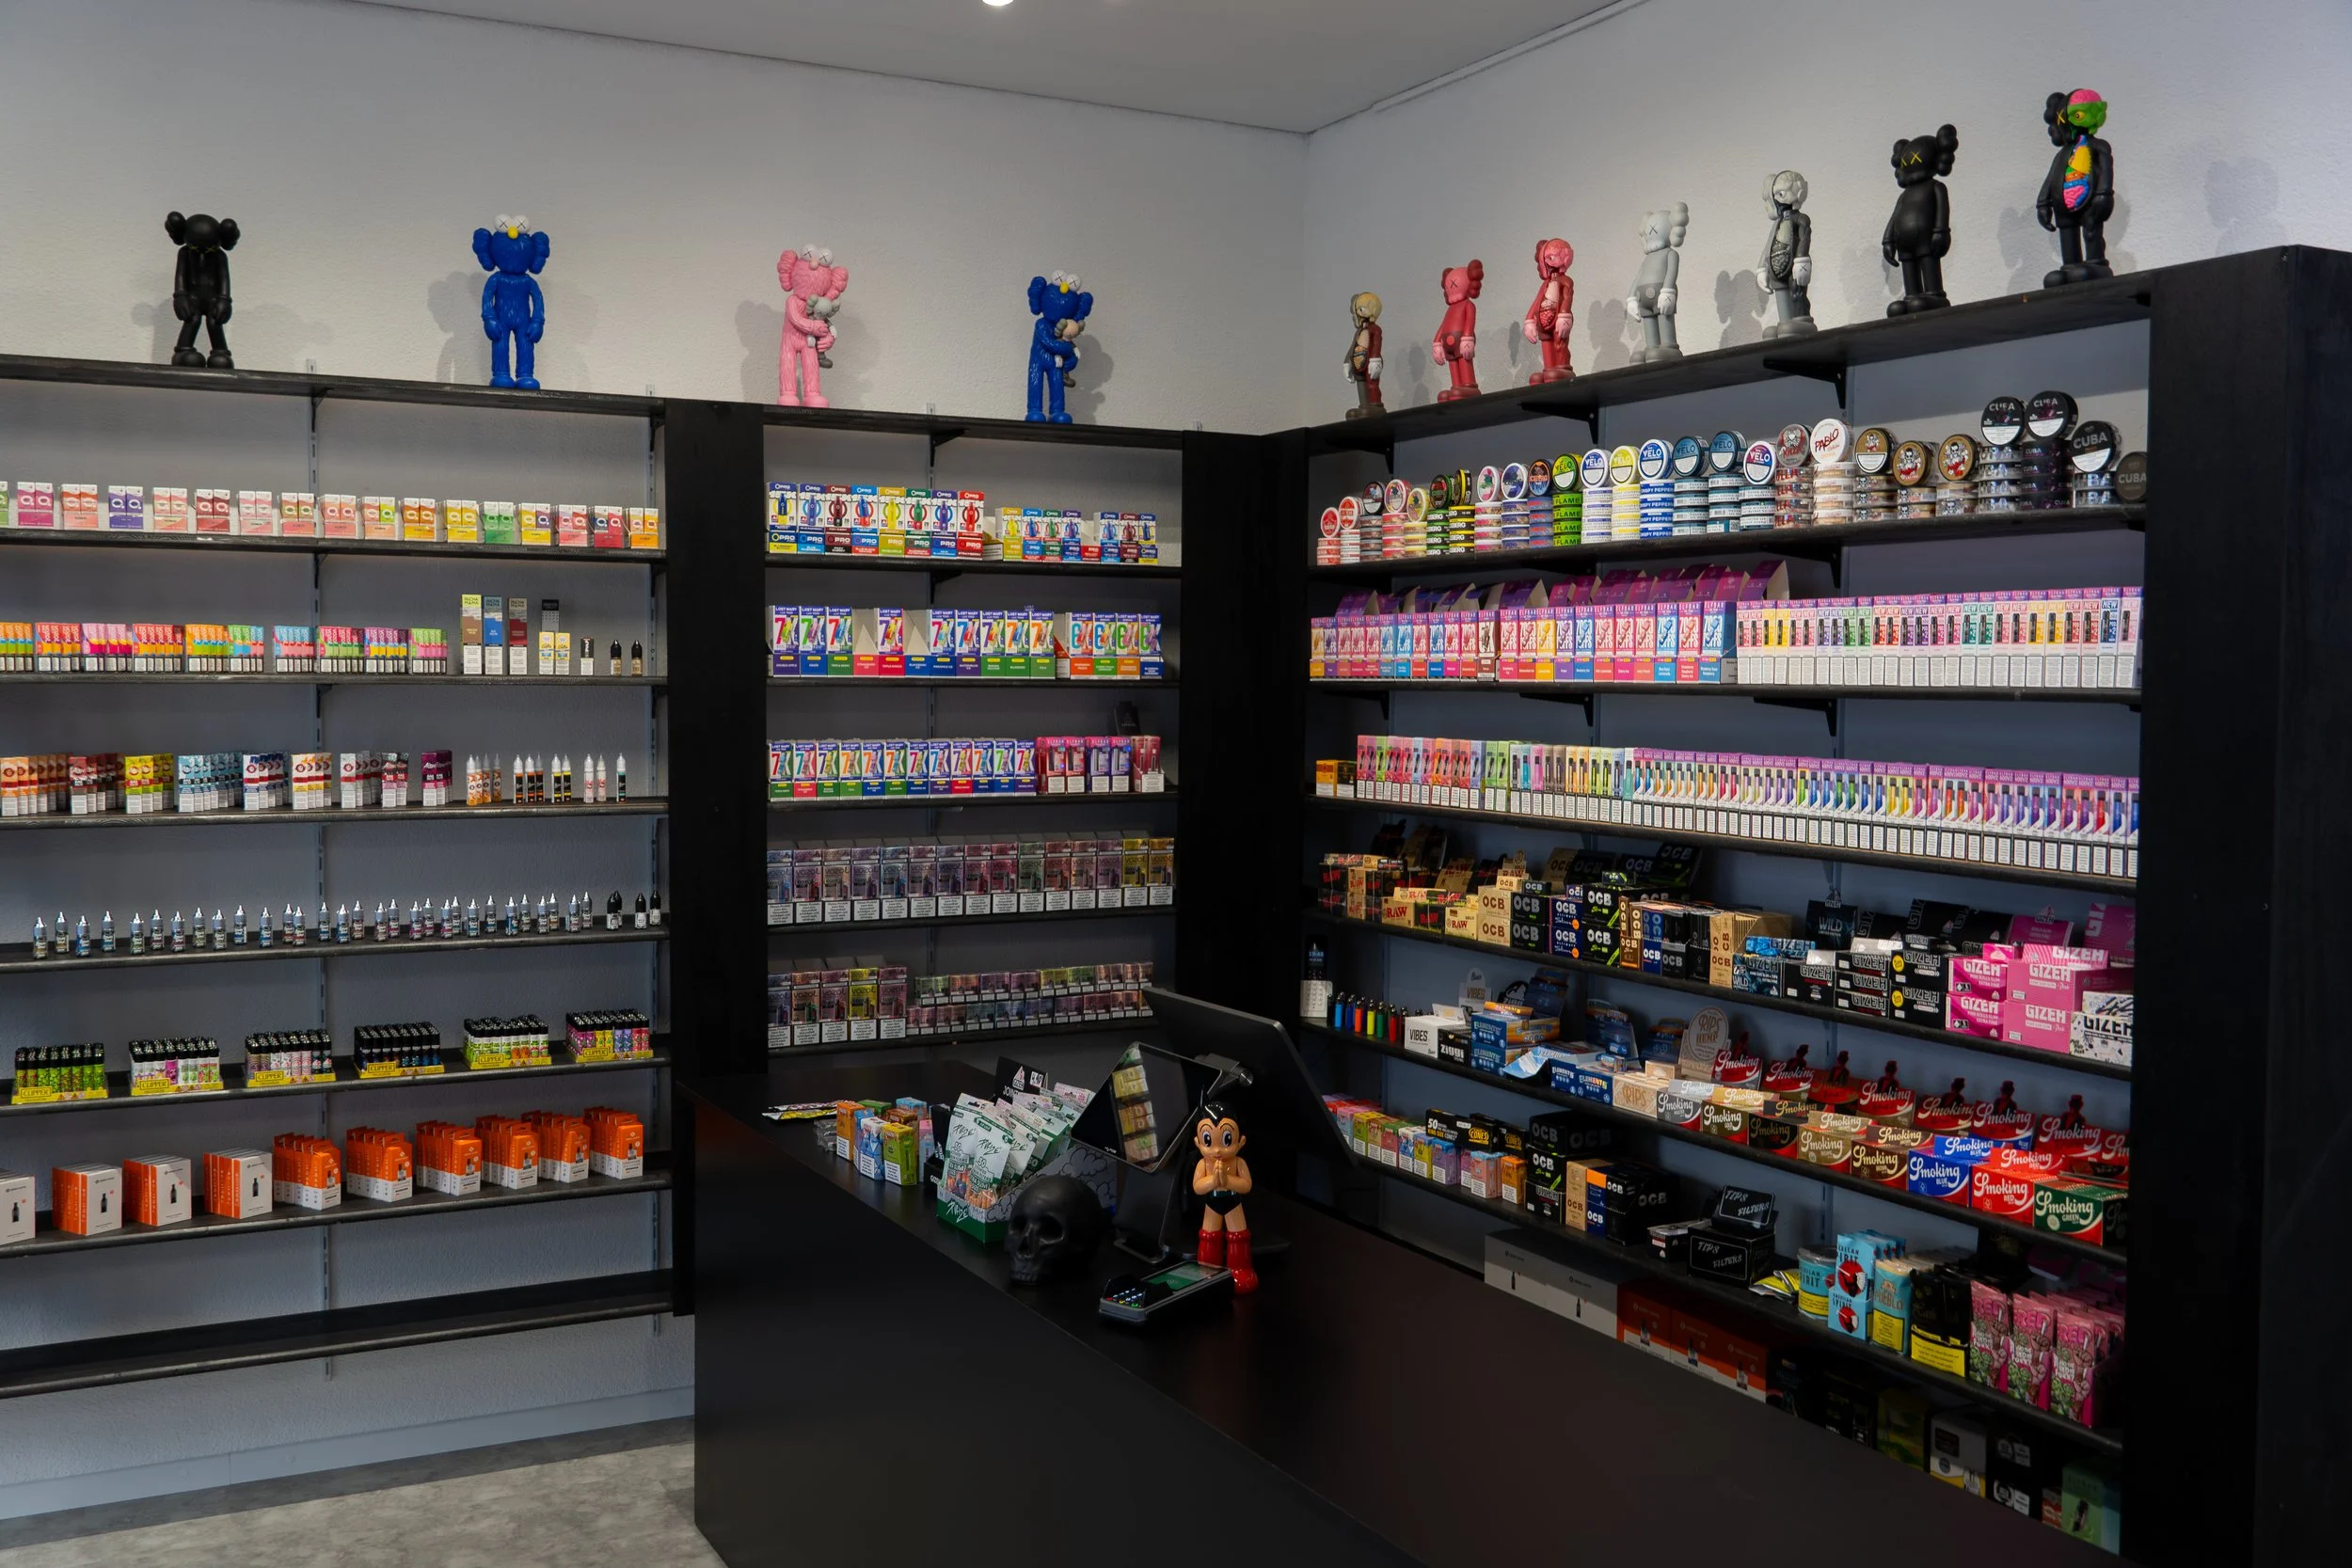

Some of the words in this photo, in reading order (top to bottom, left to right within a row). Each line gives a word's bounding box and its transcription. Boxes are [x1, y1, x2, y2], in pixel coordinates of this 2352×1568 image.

[1713, 440, 1733, 450] VELO
[2073, 432, 2108, 449] CUBA
[1643, 448, 1662, 458] VELO
[1676, 444, 1695, 455] VELO
[1750, 451, 1771, 464] VELO
[1555, 461, 1573, 471] VELO
[2119, 472, 2147, 483] CUBA
[1661, 846, 1693, 860] OCB
[1626, 858, 1654, 872] OCB
[1525, 882, 1543, 891] OCB
[1483, 895, 1505, 910] OCB
[1514, 895, 1540, 912] OCB
[1587, 891, 1612, 906] OCB
[1824, 900, 1841, 909] GIZEH
[1387, 907, 1407, 918] RAW
[1556, 901, 1577, 915] OCB
[1421, 912, 1438, 923] RAW
[1452, 920, 1468, 928] RAW
[1819, 917, 1843, 931] WILD
[1483, 923, 1505, 937] OCB
[1513, 923, 1539, 941] OCB
[1555, 929, 1577, 943] OCB
[1587, 928, 1612, 945] OCB
[1621, 938, 1638, 948] OCB
[1644, 949, 1661, 960] OCB
[1662, 955, 1683, 966] OCB
[1902, 951, 1941, 967] GIZEH
[2052, 945, 2104, 961] GIZEH
[1712, 957, 1730, 966] OCB
[1746, 957, 1778, 973] GIZEH
[1852, 955, 1885, 971] GIZEH
[1963, 959, 2001, 976] GIZEH
[1800, 965, 1833, 980] GIZEH
[2029, 964, 2070, 981] GIZEH
[1733, 974, 1749, 987] WILD
[1852, 974, 1887, 990] GIZEH
[1467, 988, 1486, 999] VIBES
[1851, 993, 1886, 1009] GIZEH
[1902, 987, 1940, 1004] GIZEH
[1961, 997, 1999, 1014] GIZEH
[2026, 1004, 2066, 1023] GIZEH
[1699, 1014, 1723, 1032] RIPS
[1409, 1029, 1428, 1041] VIBES
[1715, 1050, 1760, 1076] Smoking
[1552, 1066, 1575, 1079] ELEMENTS
[1766, 1063, 1814, 1084] Smoking
[142, 1081, 169, 1089] CLIPPER
[1579, 1074, 1608, 1090] ELEMENTS
[1681, 1082, 1715, 1095] Smoking
[1623, 1085, 1646, 1106] RIPS
[1724, 1088, 1764, 1103] Smoking
[1859, 1083, 1911, 1111] Smoking
[1659, 1093, 1694, 1119] Smoking
[1775, 1101, 1818, 1117] Smoking
[1917, 1098, 1976, 1126] Smoking
[1427, 1118, 1438, 1130] 50
[1704, 1105, 1742, 1132] Smoking
[1820, 1113, 1861, 1132] Smoking
[1974, 1102, 2032, 1135] Smoking
[1532, 1121, 1558, 1143] OCB
[1750, 1117, 1790, 1144] Smoking
[1878, 1127, 1922, 1147] Smoking
[2039, 1117, 2101, 1151] Smoking
[1801, 1131, 1843, 1159] Smoking
[1945, 1136, 1994, 1157] Smoking
[978, 1157, 988, 1166] 50
[1533, 1152, 1554, 1171] OCB
[1852, 1145, 1899, 1175] Smoking
[2001, 1148, 2052, 1170] Smoking
[1909, 1156, 1961, 1188] Smoking
[1607, 1181, 1624, 1195] OCB
[1973, 1171, 2028, 1206] Smoking
[1638, 1192, 1667, 1207] OCB
[1724, 1189, 1749, 1203] TIPS
[1567, 1199, 1583, 1211] OCB
[1738, 1202, 1770, 1216] FILTERS
[2035, 1190, 2094, 1226] Smoking
[1587, 1211, 1603, 1224] OCB
[2062, 1213, 2080, 1222] GREEN
[1697, 1241, 1720, 1254] TIPS
[1712, 1254, 1743, 1269] FILTERS
[1875, 1291, 1903, 1310] PUEBLO
